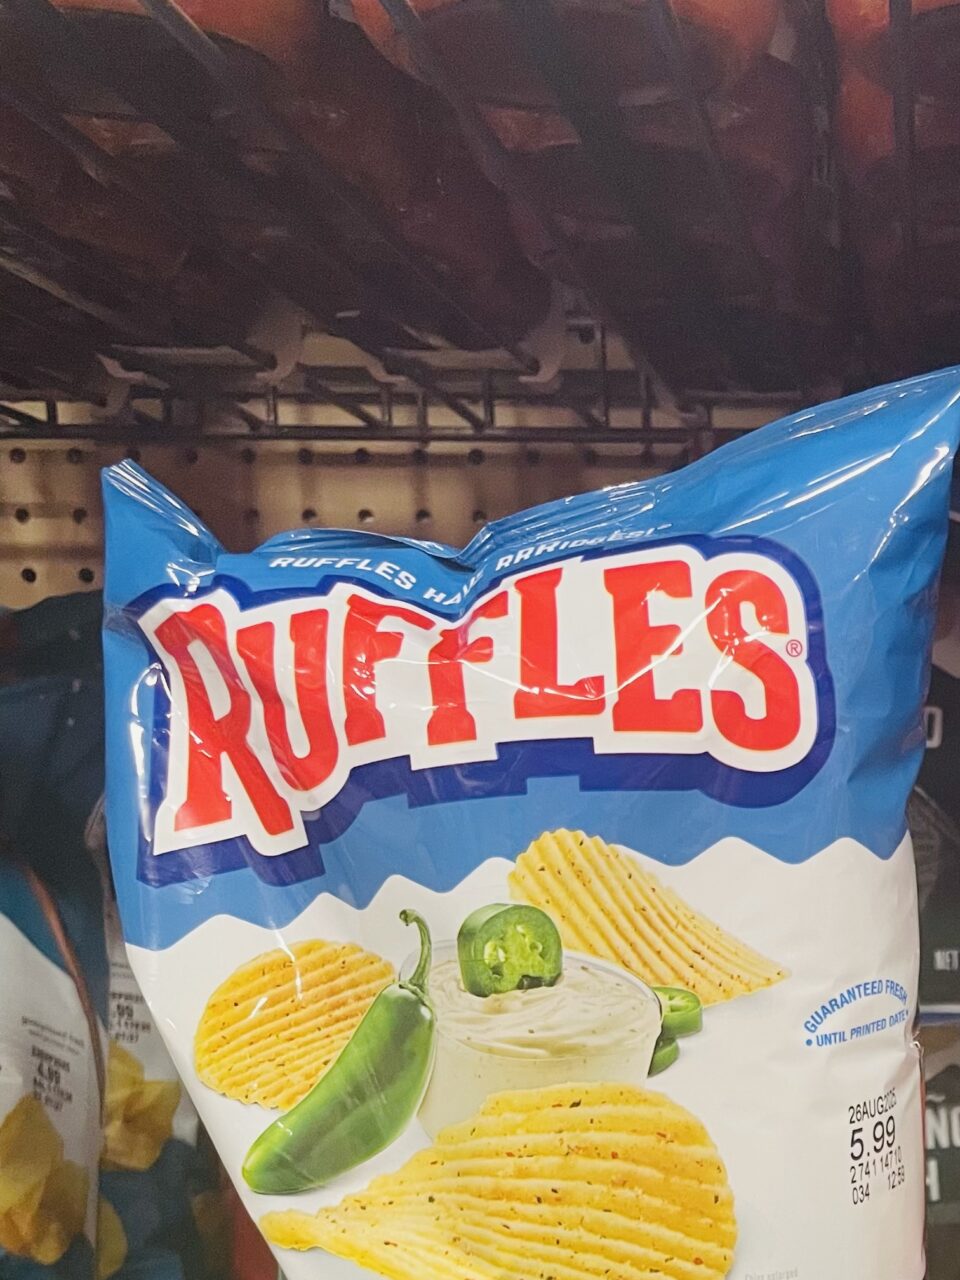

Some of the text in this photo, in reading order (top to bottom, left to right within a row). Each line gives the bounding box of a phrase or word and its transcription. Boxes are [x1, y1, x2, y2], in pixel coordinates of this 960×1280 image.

[270, 556, 418, 591] RUFFLES
[150, 556, 803, 842] RUFFLES
[803, 979, 908, 1034] GUARANTEED FRESH
[816, 1029, 847, 1047] UNTIL
[849, 1018, 887, 1041] PRINTED
[850, 1115, 896, 1161] 5.99
